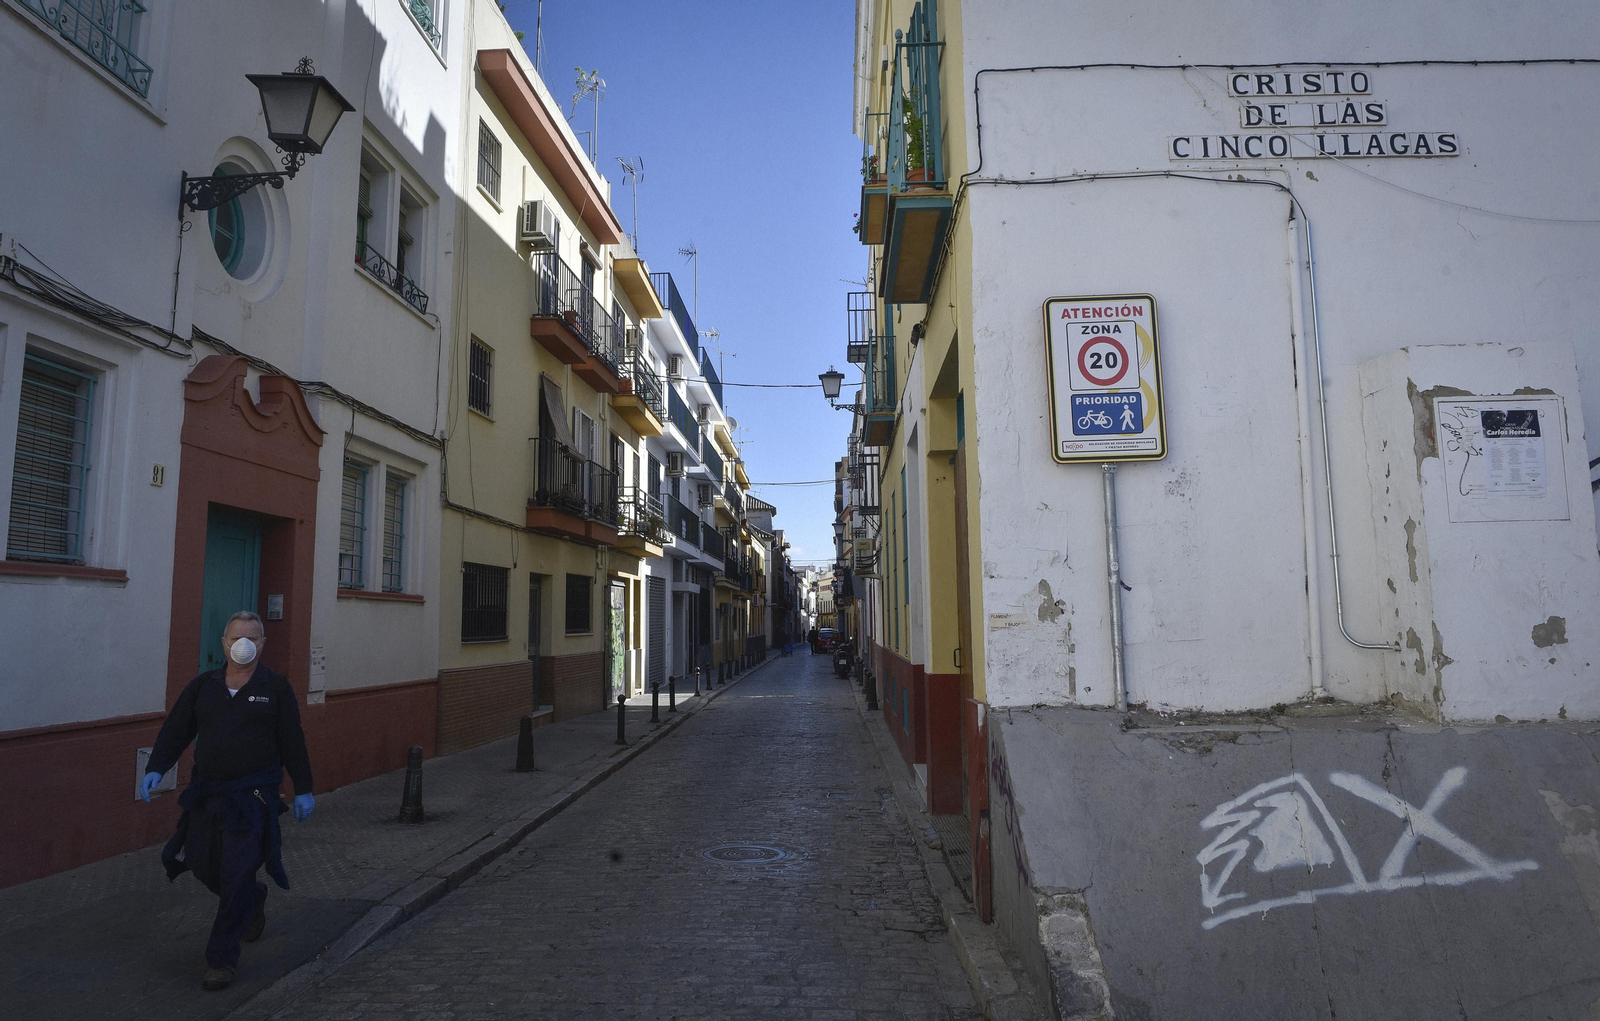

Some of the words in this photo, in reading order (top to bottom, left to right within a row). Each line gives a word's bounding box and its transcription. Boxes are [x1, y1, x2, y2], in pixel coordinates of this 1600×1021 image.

[1231, 72, 1370, 95] CRISTO
[1244, 104, 1287, 126] DE
[1317, 102, 1385, 125] LAS
[1172, 135, 1288, 158] CINCO
[1316, 133, 1458, 156] LLAGAS
[1061, 303, 1143, 319] ATENCIÓN
[1081, 324, 1122, 335] ZONA
[1089, 351, 1118, 369] 20
[1075, 395, 1137, 405] PRIORIDAD
[1508, 428, 1536, 436] Heredia
[153, 465, 164, 484] 81
